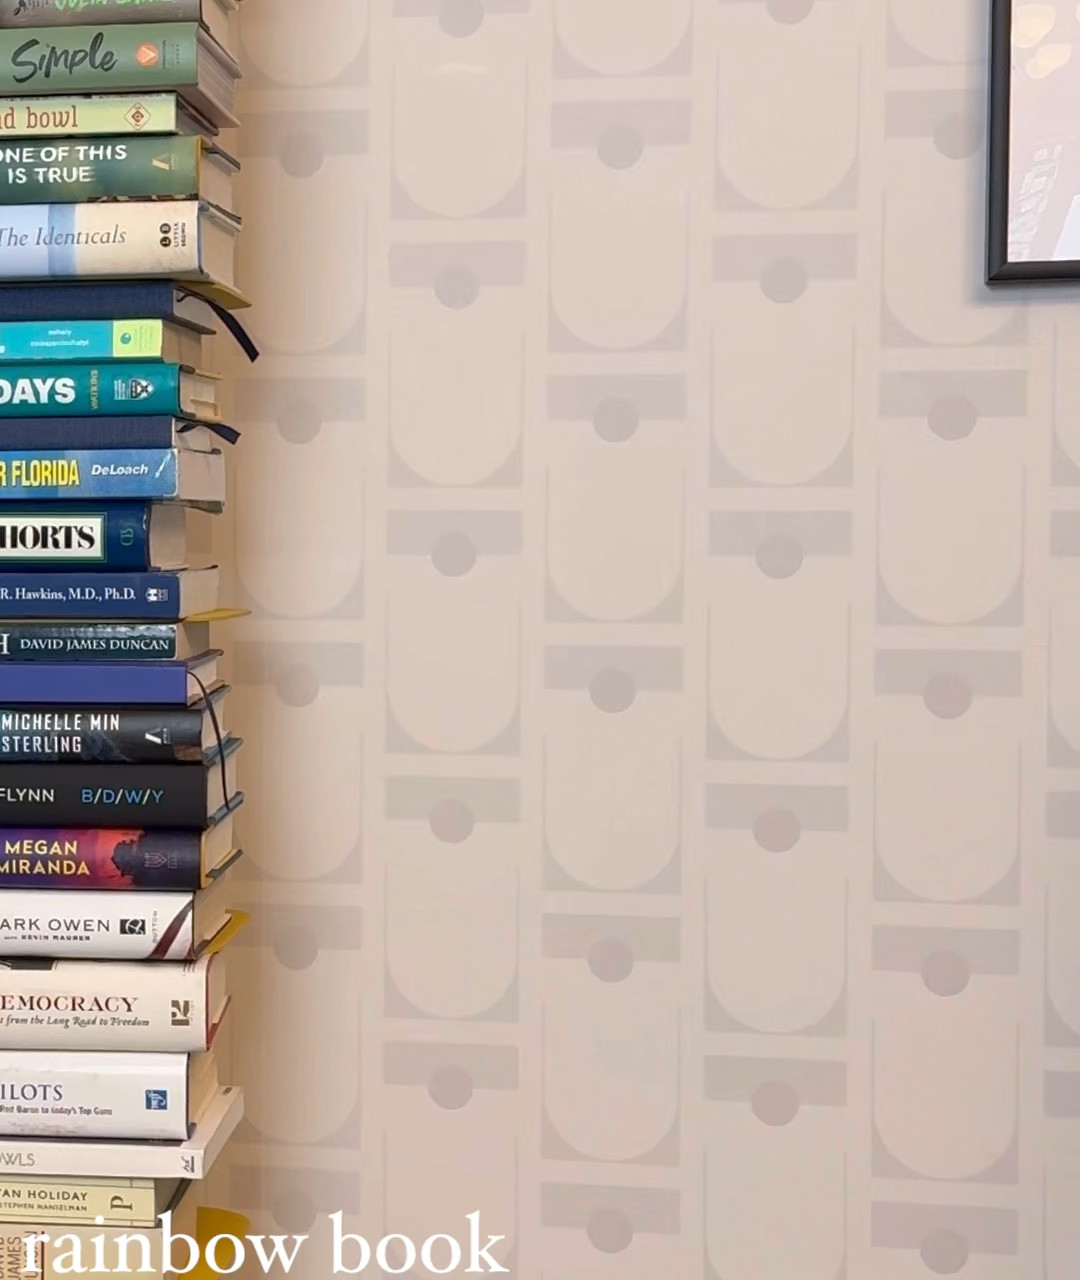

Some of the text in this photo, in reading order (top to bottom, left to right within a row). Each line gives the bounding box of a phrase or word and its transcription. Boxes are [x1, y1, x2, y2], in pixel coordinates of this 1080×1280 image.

[11, 31, 117, 83] Simple
[25, 105, 78, 128] bowl
[40, 146, 70, 161] OF
[75, 144, 127, 160] THIS
[8, 167, 94, 184] IS TRUE
[35, 225, 126, 246] Identicals
[11, 459, 80, 487] FLORIDA
[91, 464, 149, 477] DeLoach
[21, 638, 169, 652] DAVID JAMES DUNCAN
[1, 713, 120, 731] MICHELLE MIN
[1, 735, 82, 753] STERLING
[5, 840, 77, 856] MEGAN
[28, 1189, 88, 1201] HOLIDAY
